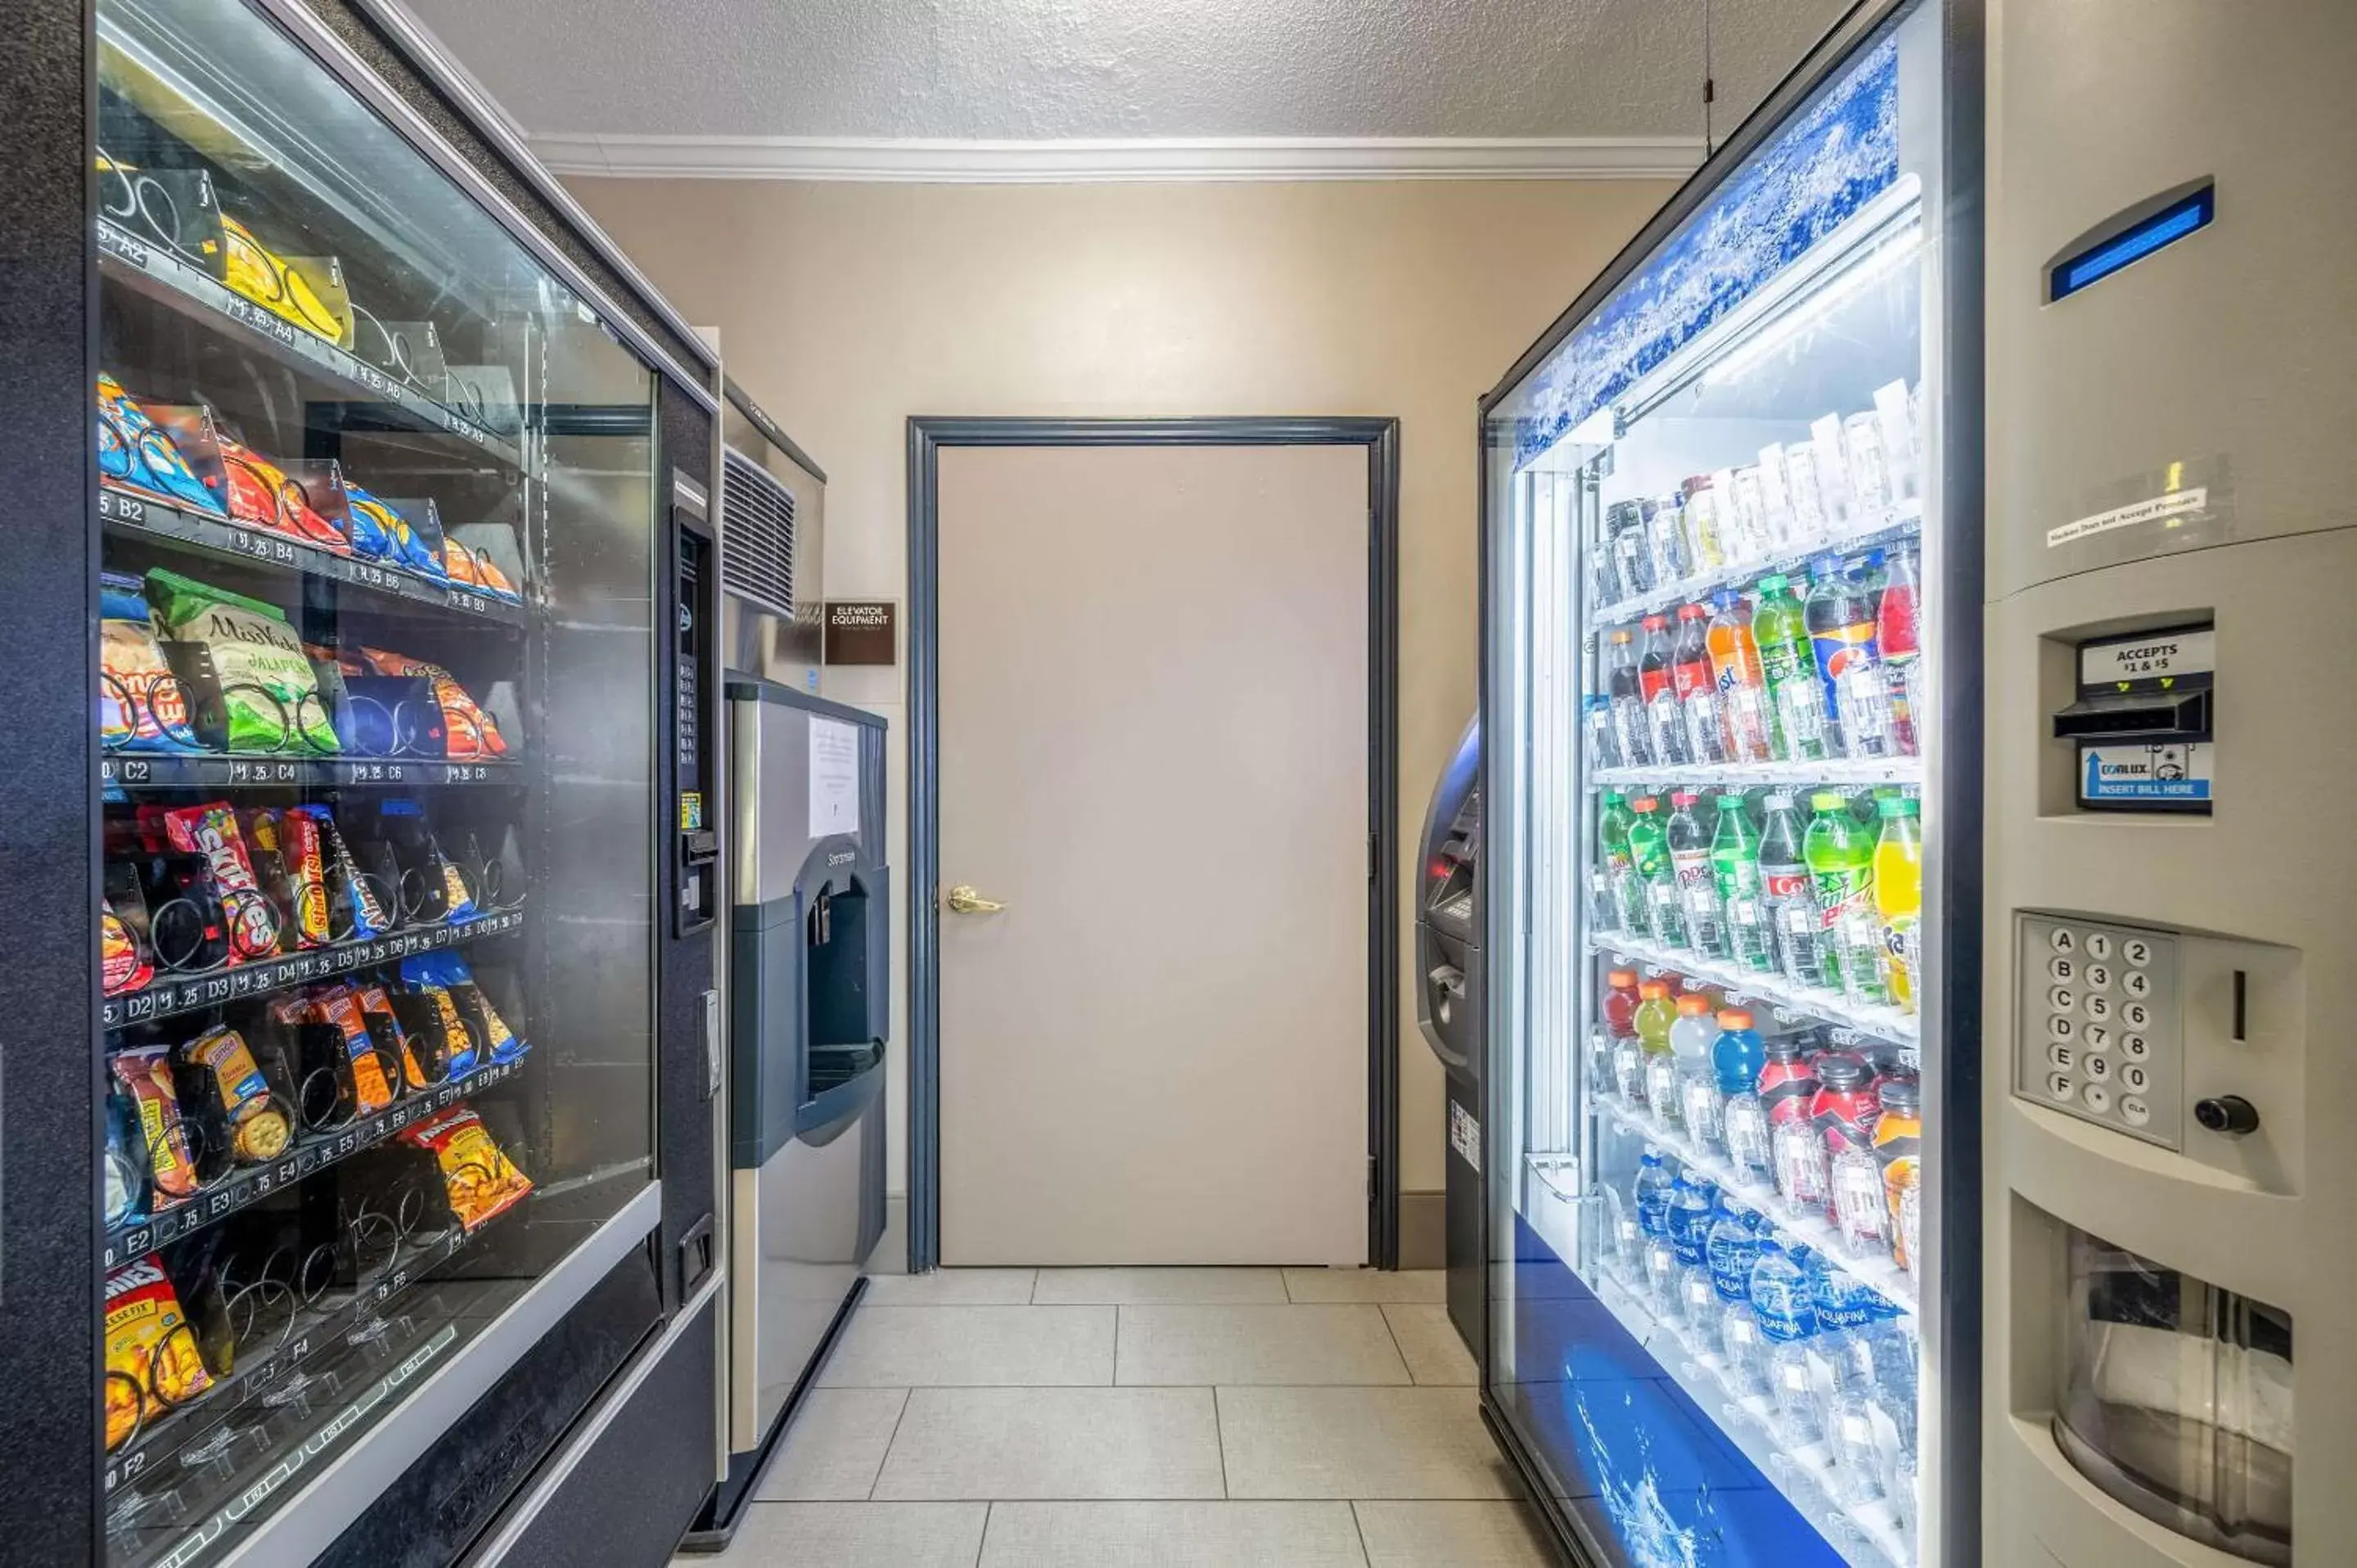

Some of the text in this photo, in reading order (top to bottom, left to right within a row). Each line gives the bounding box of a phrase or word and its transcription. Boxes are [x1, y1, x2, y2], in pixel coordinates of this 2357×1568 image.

[119, 497, 143, 521] B2
[2119, 507, 2152, 521] Accept
[276, 543, 294, 561] B4
[831, 615, 890, 625] EQUIPMENT
[836, 606, 883, 615] ELEVATOR
[2116, 644, 2178, 662] ACCEPTS
[2141, 660, 2151, 671] &
[124, 761, 148, 780] C2
[278, 766, 295, 780] C4
[389, 766, 402, 780] C6
[2098, 783, 2195, 795] INSERT BILL HERE
[338, 952, 353, 967] D5
[435, 930, 447, 943] D7
[2057, 933, 2145, 961] A 1 2
[2057, 961, 2145, 992] B 3 4
[128, 997, 151, 1018] D2
[208, 980, 229, 997] D3
[278, 964, 297, 981] D4
[2057, 990, 2144, 1023] C 5 6
[2057, 1019, 2144, 1054] D 7 8
[2057, 1048, 2143, 1086] E 9 0
[2057, 1077, 2070, 1093] F
[392, 1111, 406, 1129] E6
[439, 1089, 450, 1105] E7
[127, 1230, 149, 1255] E2
[210, 1192, 231, 1215] E3
[278, 1164, 296, 1182] E4
[340, 1135, 354, 1153] E5
[293, 1338, 309, 1361] F4
[124, 1452, 146, 1480] F2
